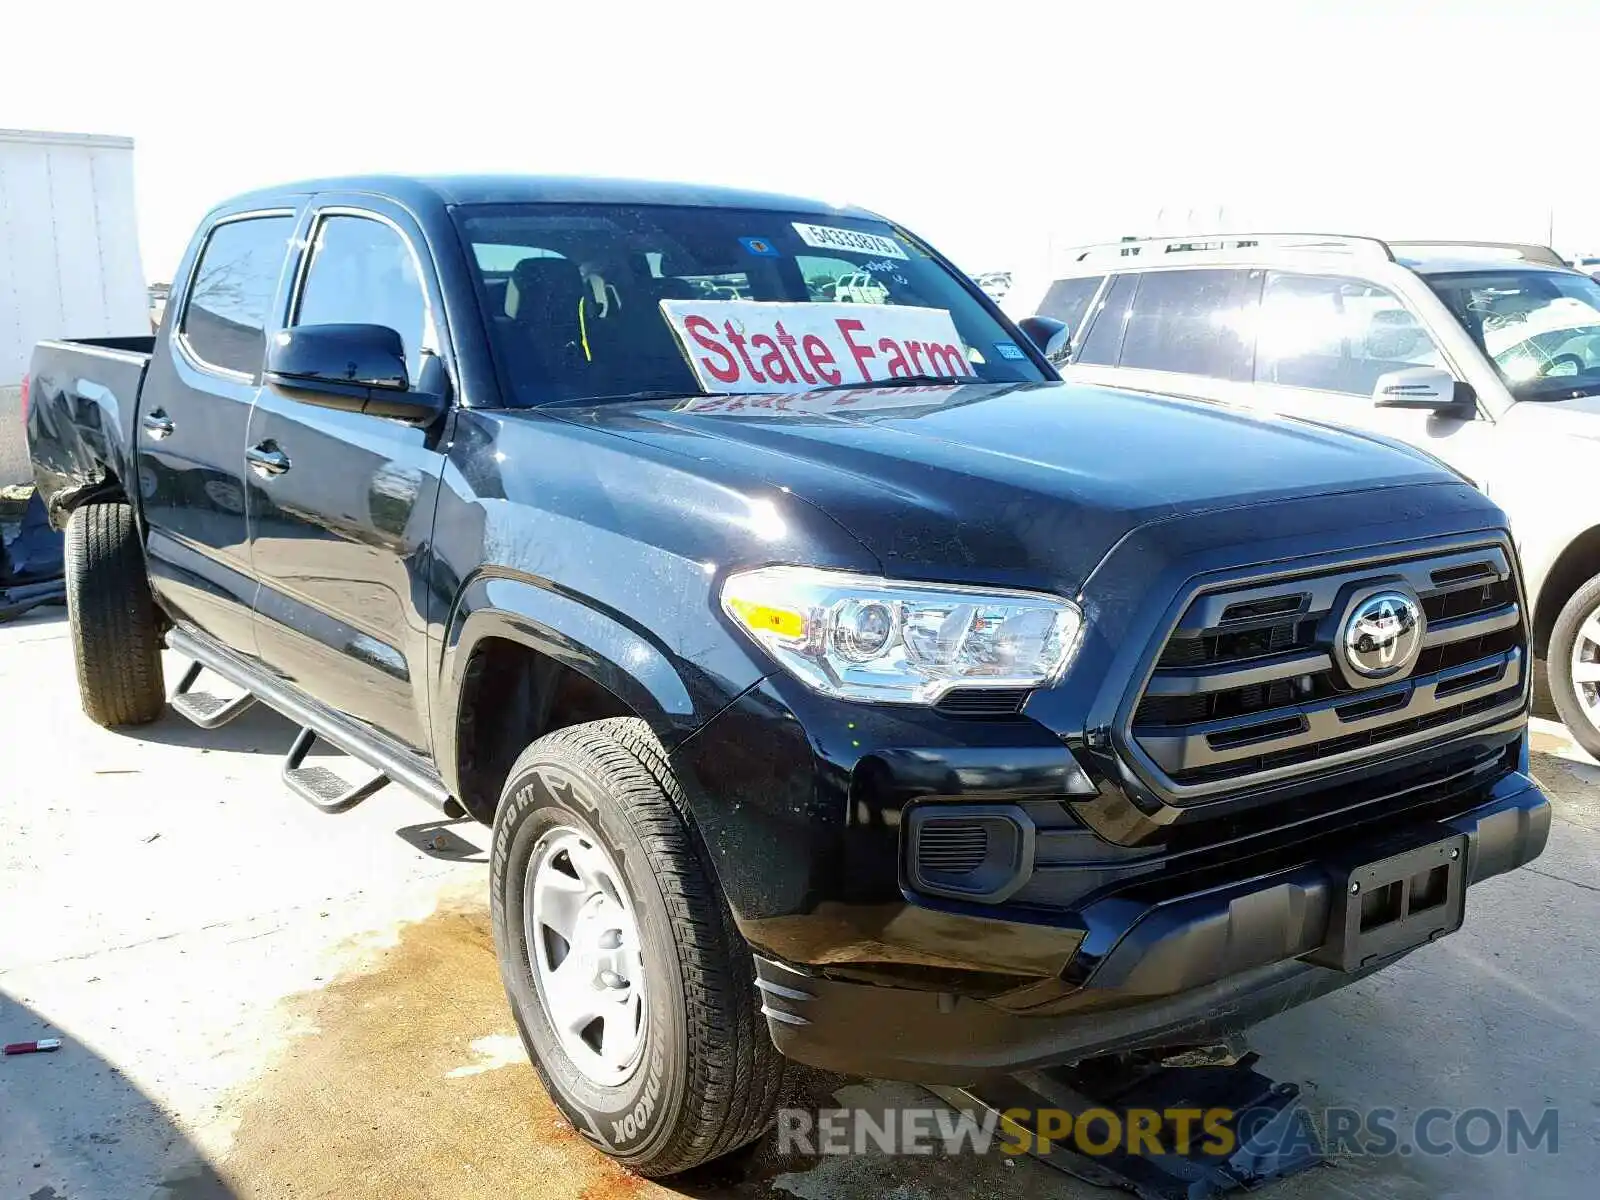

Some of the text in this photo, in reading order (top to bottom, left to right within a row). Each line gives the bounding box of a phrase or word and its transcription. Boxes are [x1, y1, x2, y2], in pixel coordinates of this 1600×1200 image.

[683, 314, 970, 386] State Farm
[515, 783, 534, 811] HT
